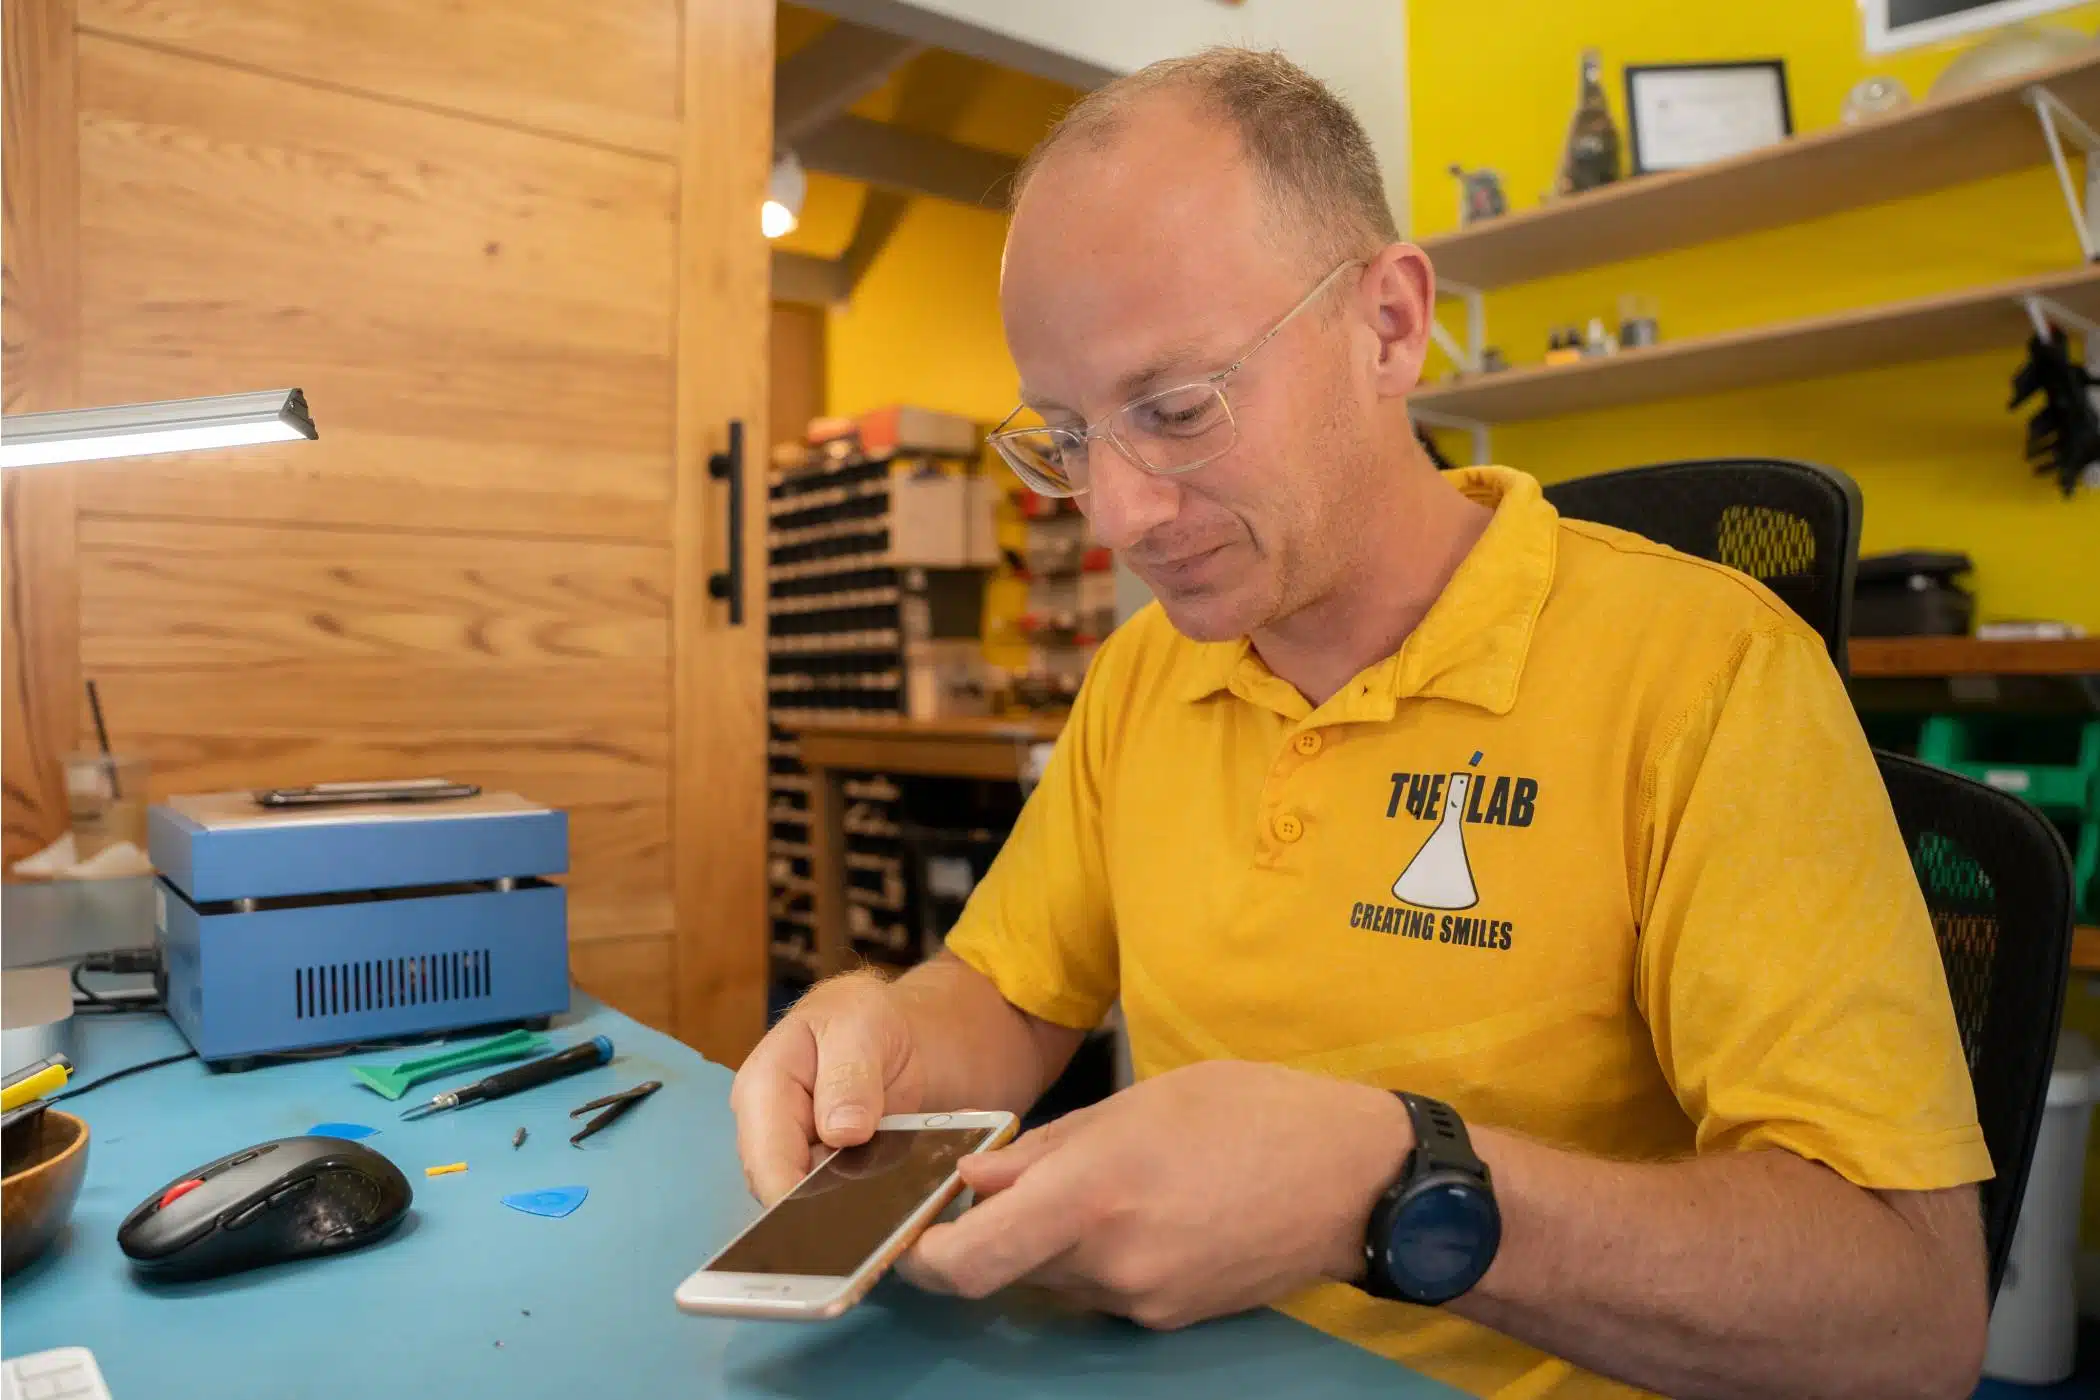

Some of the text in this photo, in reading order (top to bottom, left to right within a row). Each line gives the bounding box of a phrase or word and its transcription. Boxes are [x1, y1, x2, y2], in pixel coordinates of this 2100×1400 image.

[1386, 773, 1446, 820] THE
[1350, 901, 1513, 950] CREATING SMILES
